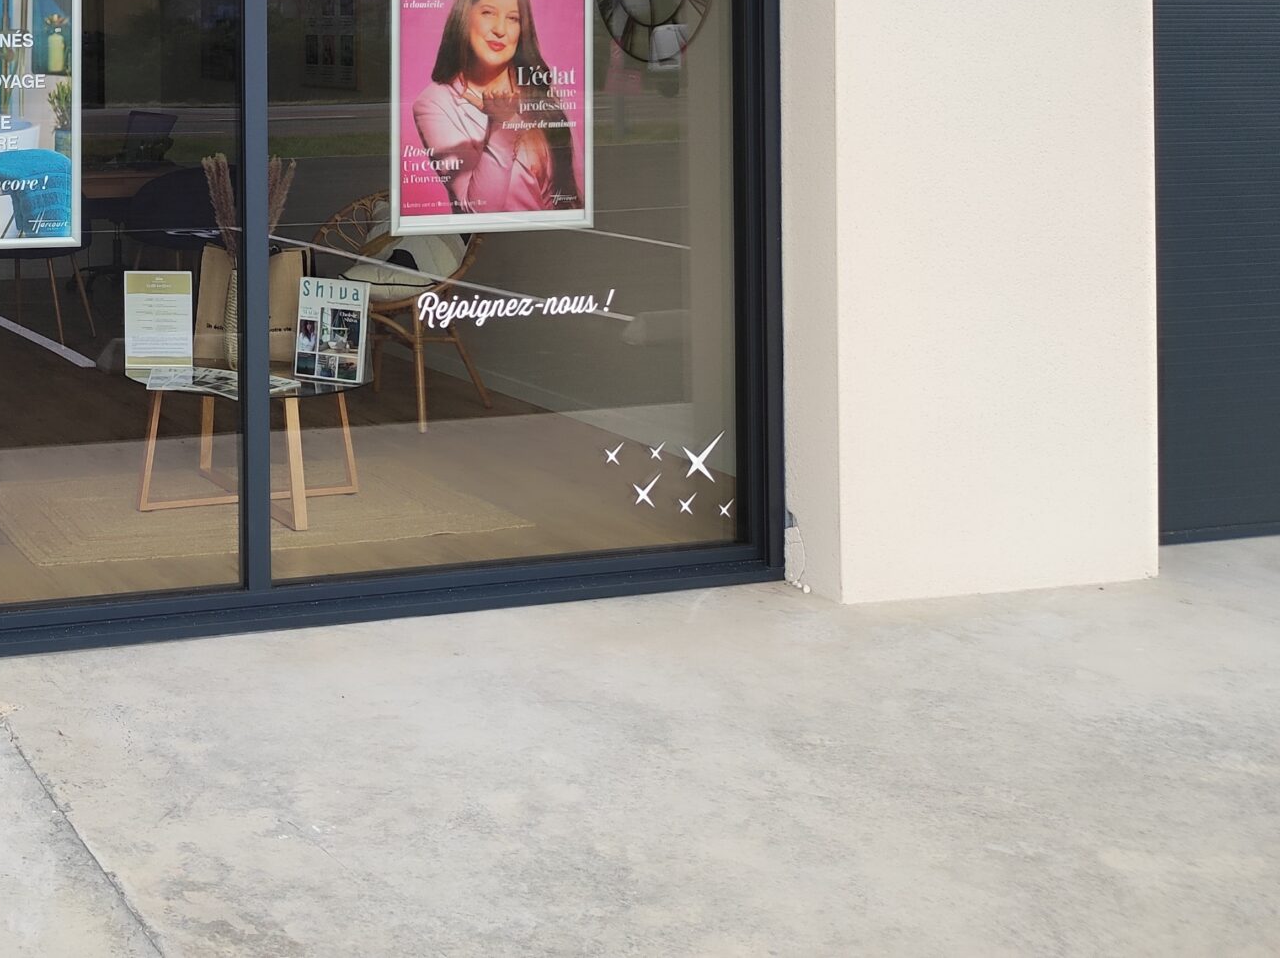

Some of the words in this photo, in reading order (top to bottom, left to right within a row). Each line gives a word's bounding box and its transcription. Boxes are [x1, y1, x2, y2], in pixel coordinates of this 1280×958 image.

[520, 99, 576, 114] profession
[403, 145, 434, 158] Rosa
[303, 280, 359, 301] Shiva
[418, 291, 598, 329] Rejoignez-nous
